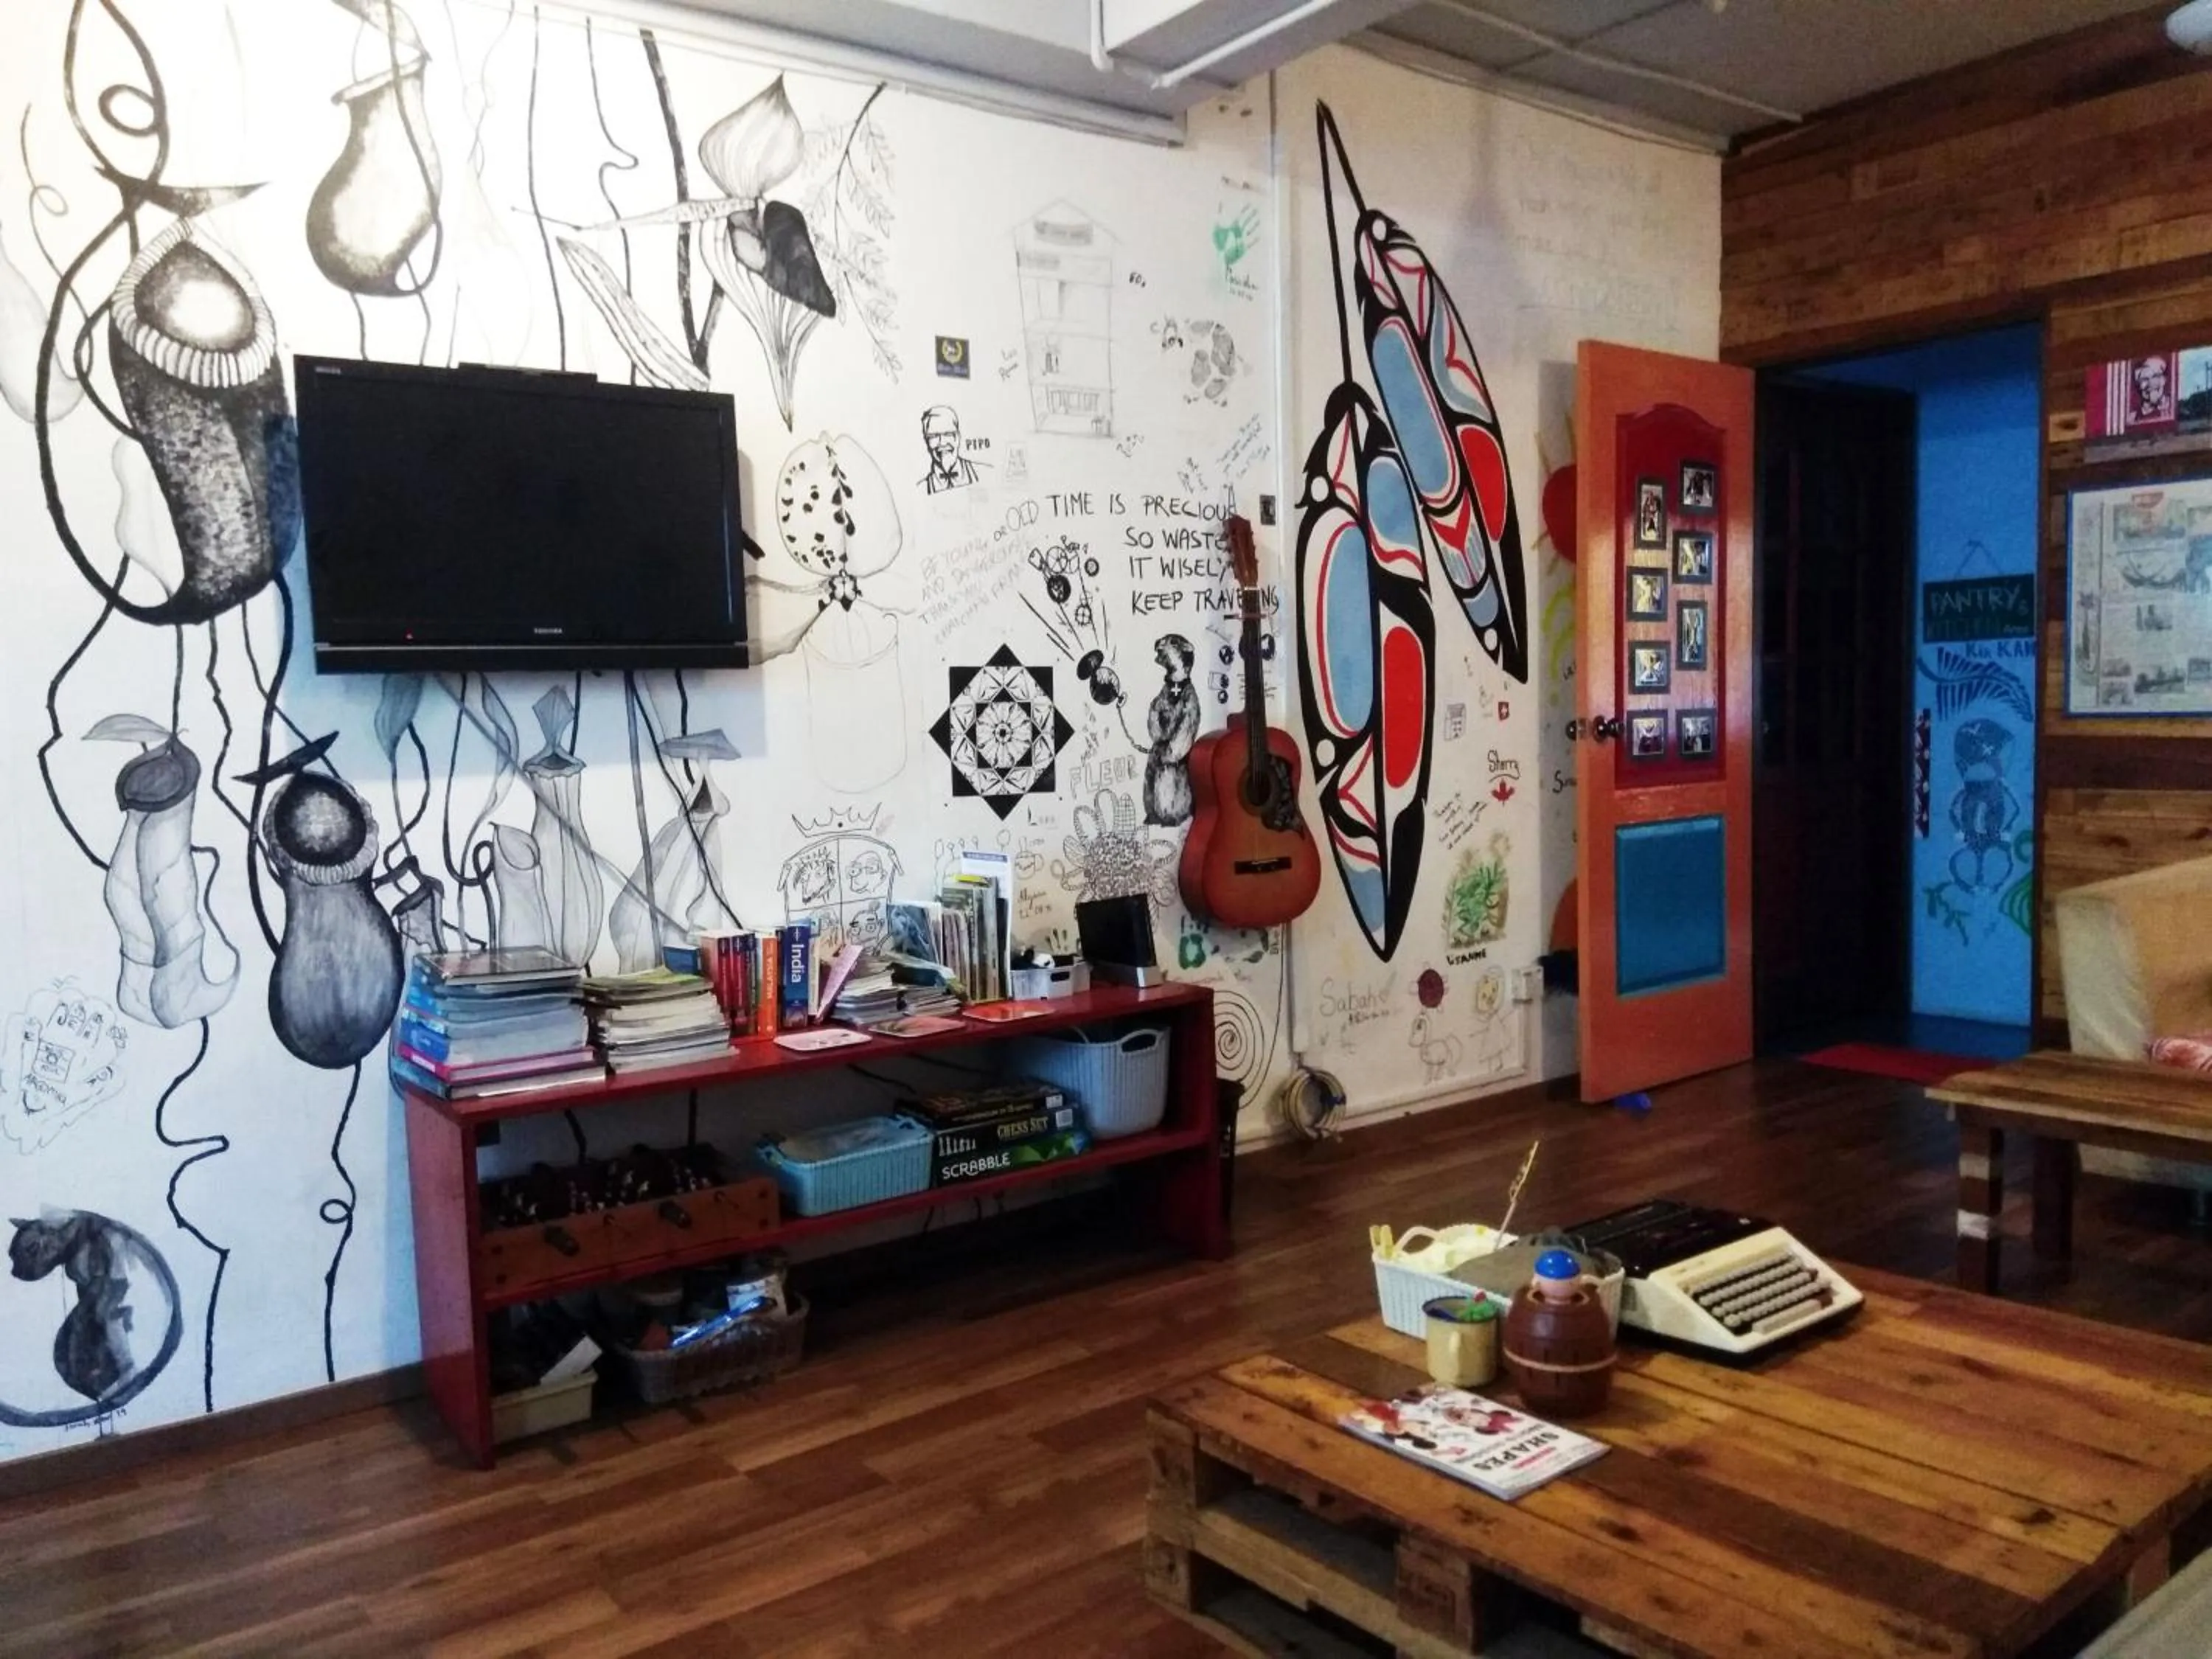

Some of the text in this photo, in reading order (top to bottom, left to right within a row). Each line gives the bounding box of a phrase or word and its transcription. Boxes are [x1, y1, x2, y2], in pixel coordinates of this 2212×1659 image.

[1046, 493, 1095, 516] TIME
[1110, 494, 1126, 515] IS
[1125, 528, 1231, 550] SO WASTE
[1129, 557, 1233, 581] IT WISELY
[1131, 588, 1283, 616] KEEP TRAVENG
[1931, 584, 2021, 616] PANTRY
[791, 943, 804, 984] India
[941, 1152, 1012, 1180] SCRABBLE
